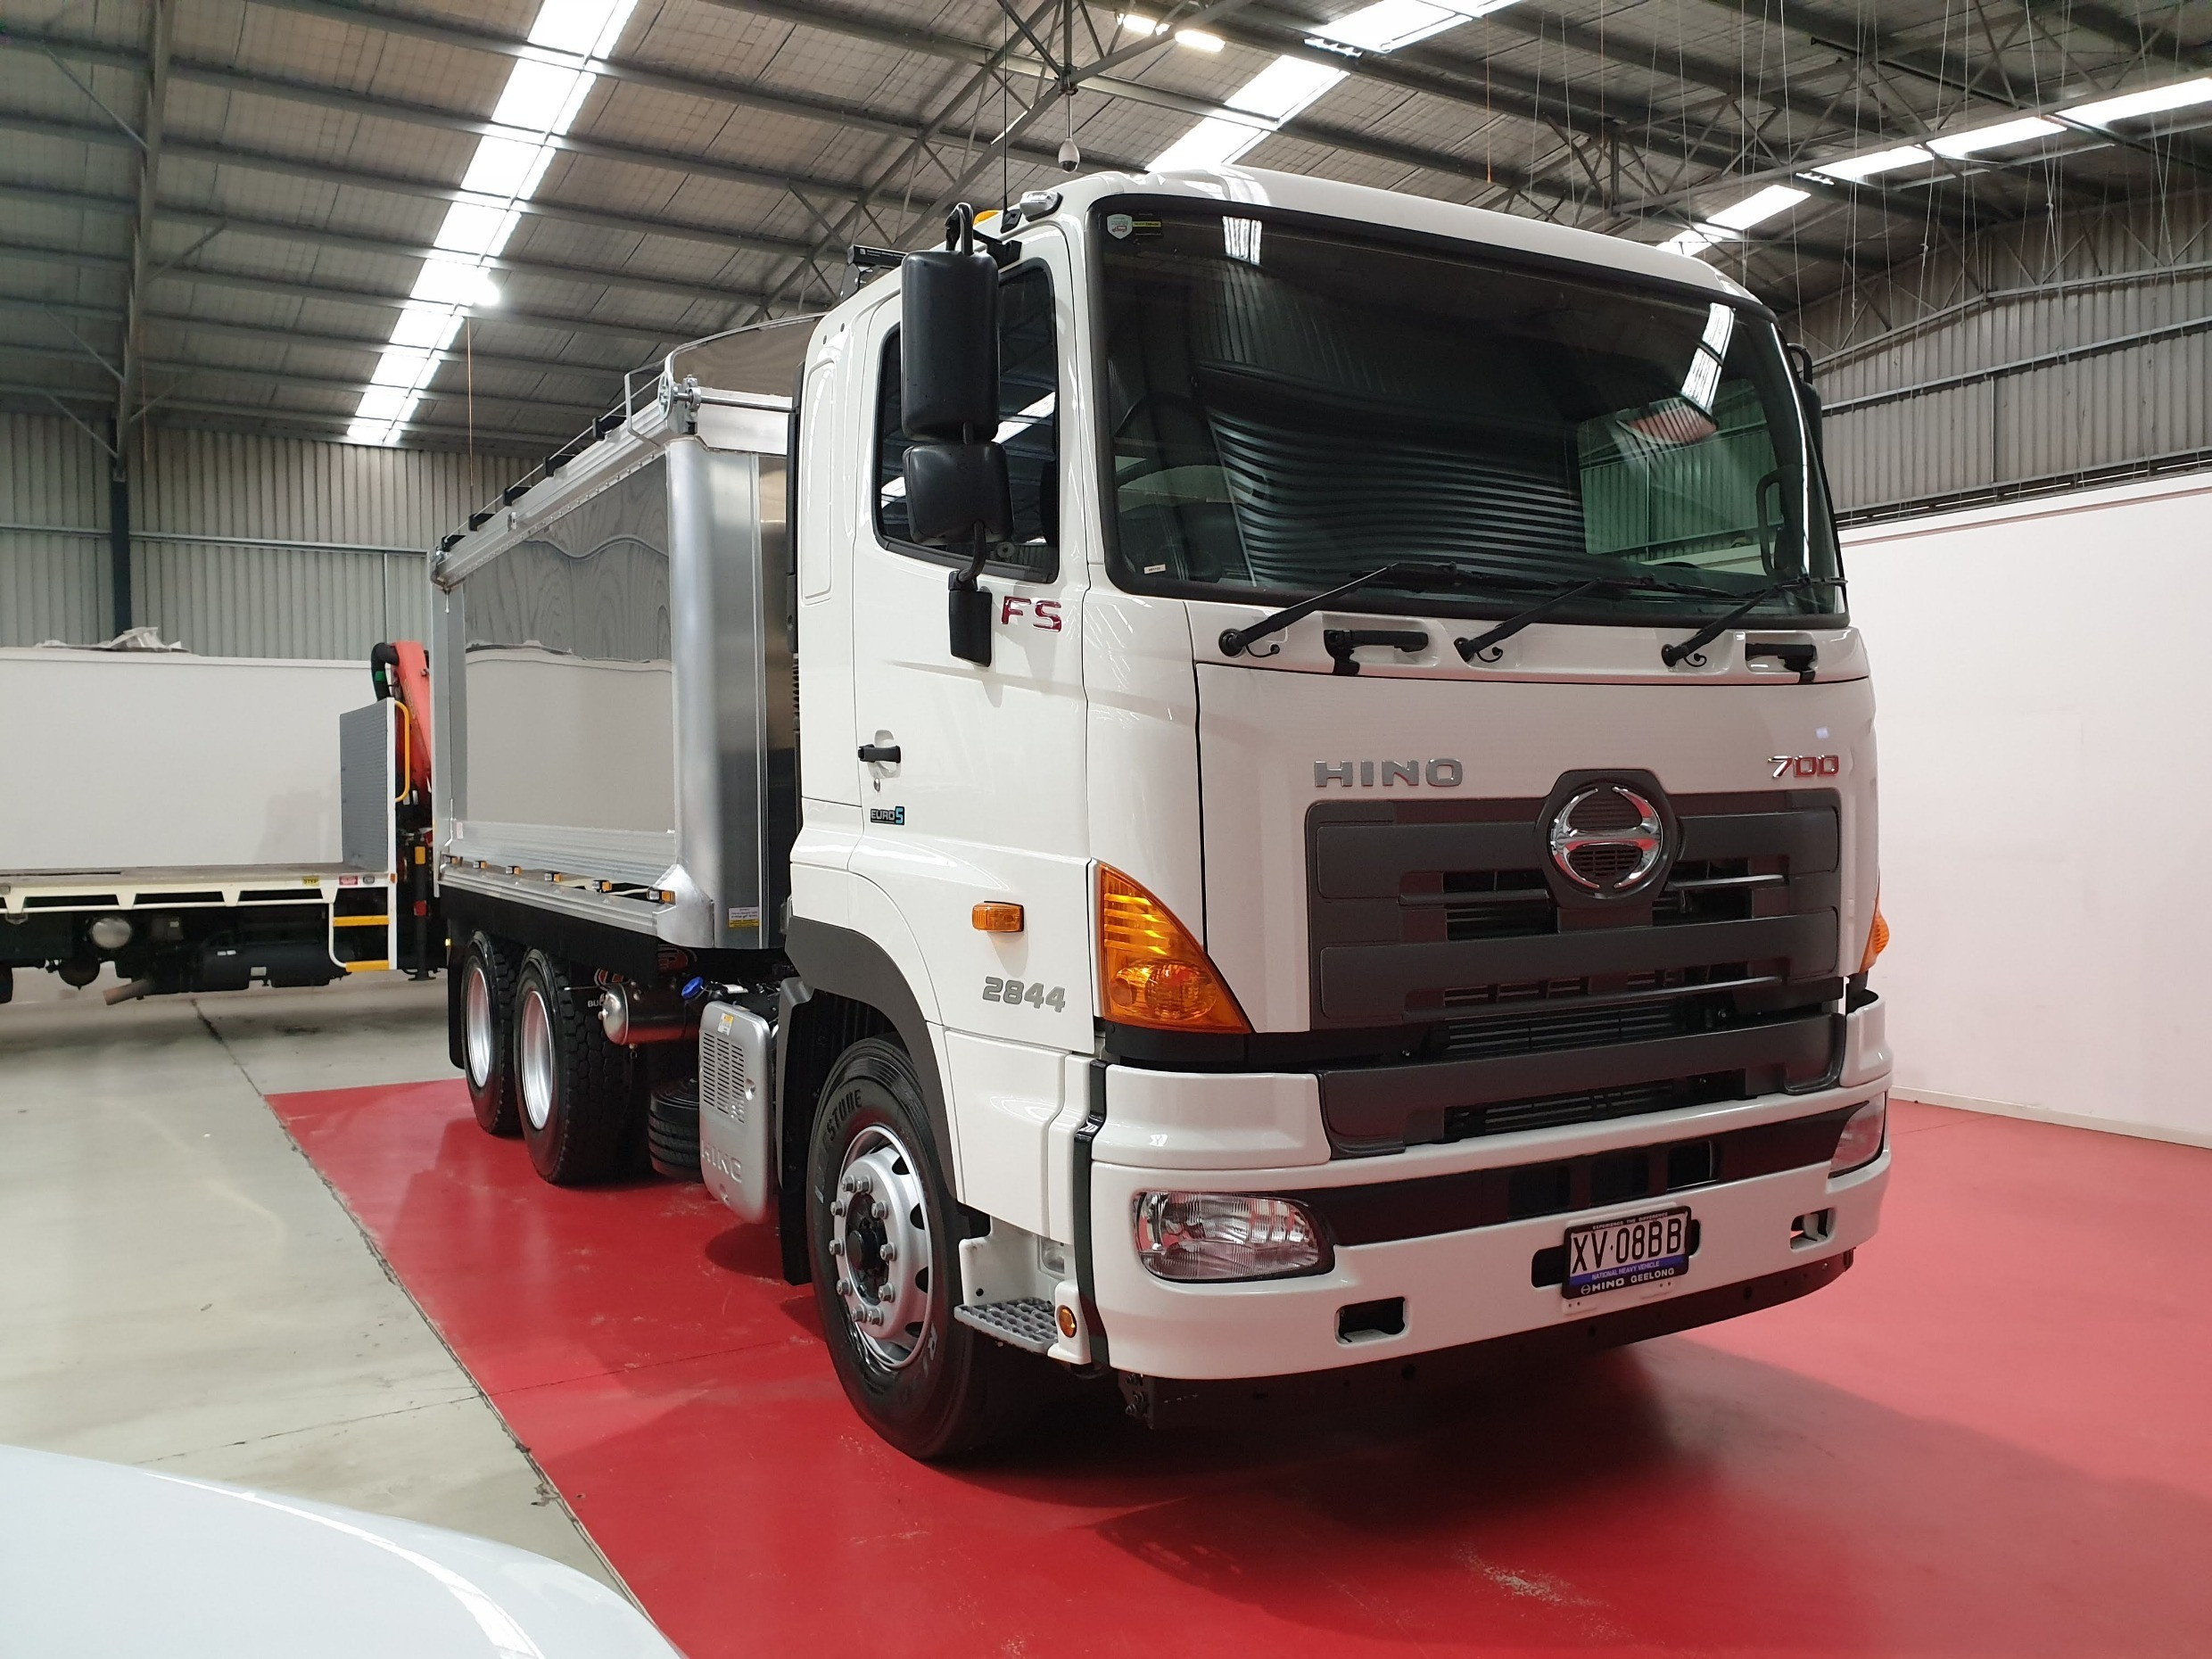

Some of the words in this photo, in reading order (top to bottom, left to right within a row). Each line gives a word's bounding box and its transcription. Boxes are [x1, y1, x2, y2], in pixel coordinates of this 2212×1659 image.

[1314, 758, 1463, 788] HINO
[1768, 755, 1839, 778] 700
[982, 976, 1065, 1012] 2844
[1591, 1270, 1618, 1280] NATIONAL
[1618, 1265, 1638, 1275] HEAVY
[1638, 1260, 1660, 1271] VEHICLE
[1592, 1277, 1624, 1292] HINO
[1630, 1267, 1675, 1283] GEELONG
